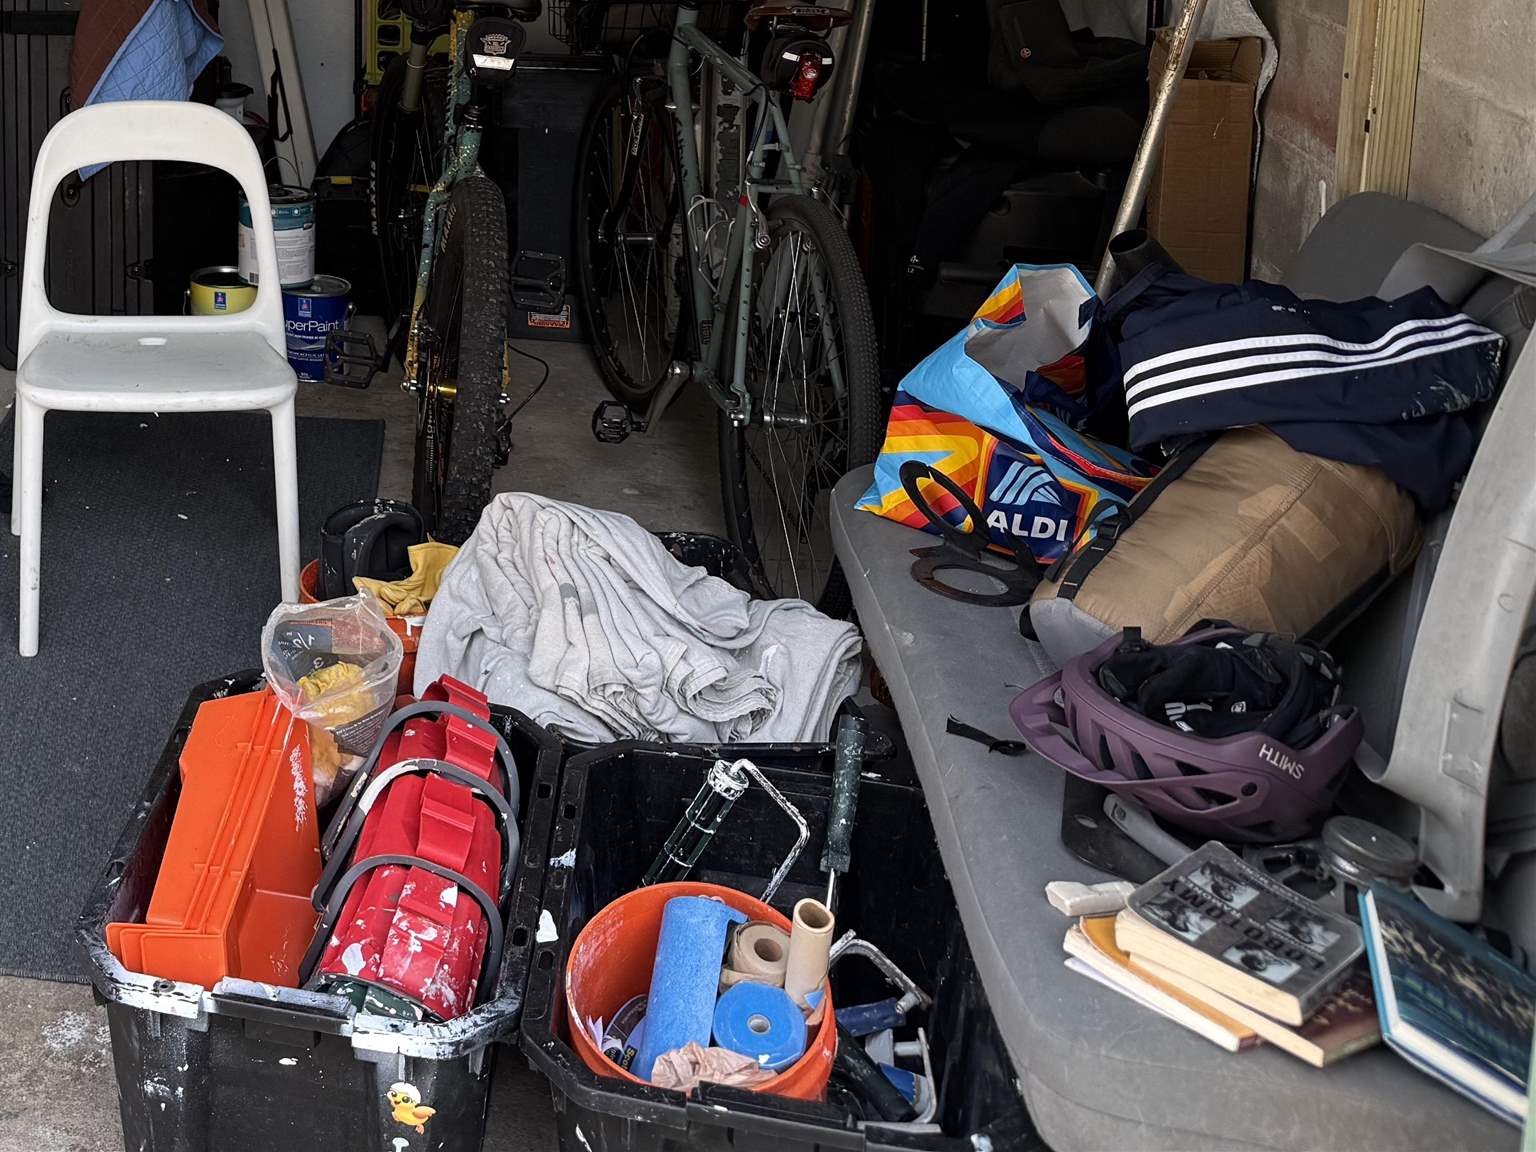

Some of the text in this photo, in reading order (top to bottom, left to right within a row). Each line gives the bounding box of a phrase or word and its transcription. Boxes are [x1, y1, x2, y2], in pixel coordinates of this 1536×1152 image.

[370, 160, 378, 236] MAXXIS
[285, 319, 338, 333] perPaint
[986, 509, 1068, 542] ALDI
[1259, 743, 1304, 779] SMITH
[1179, 875, 1241, 918] RAMONES
[1161, 879, 1326, 970] LOBOTOMY
